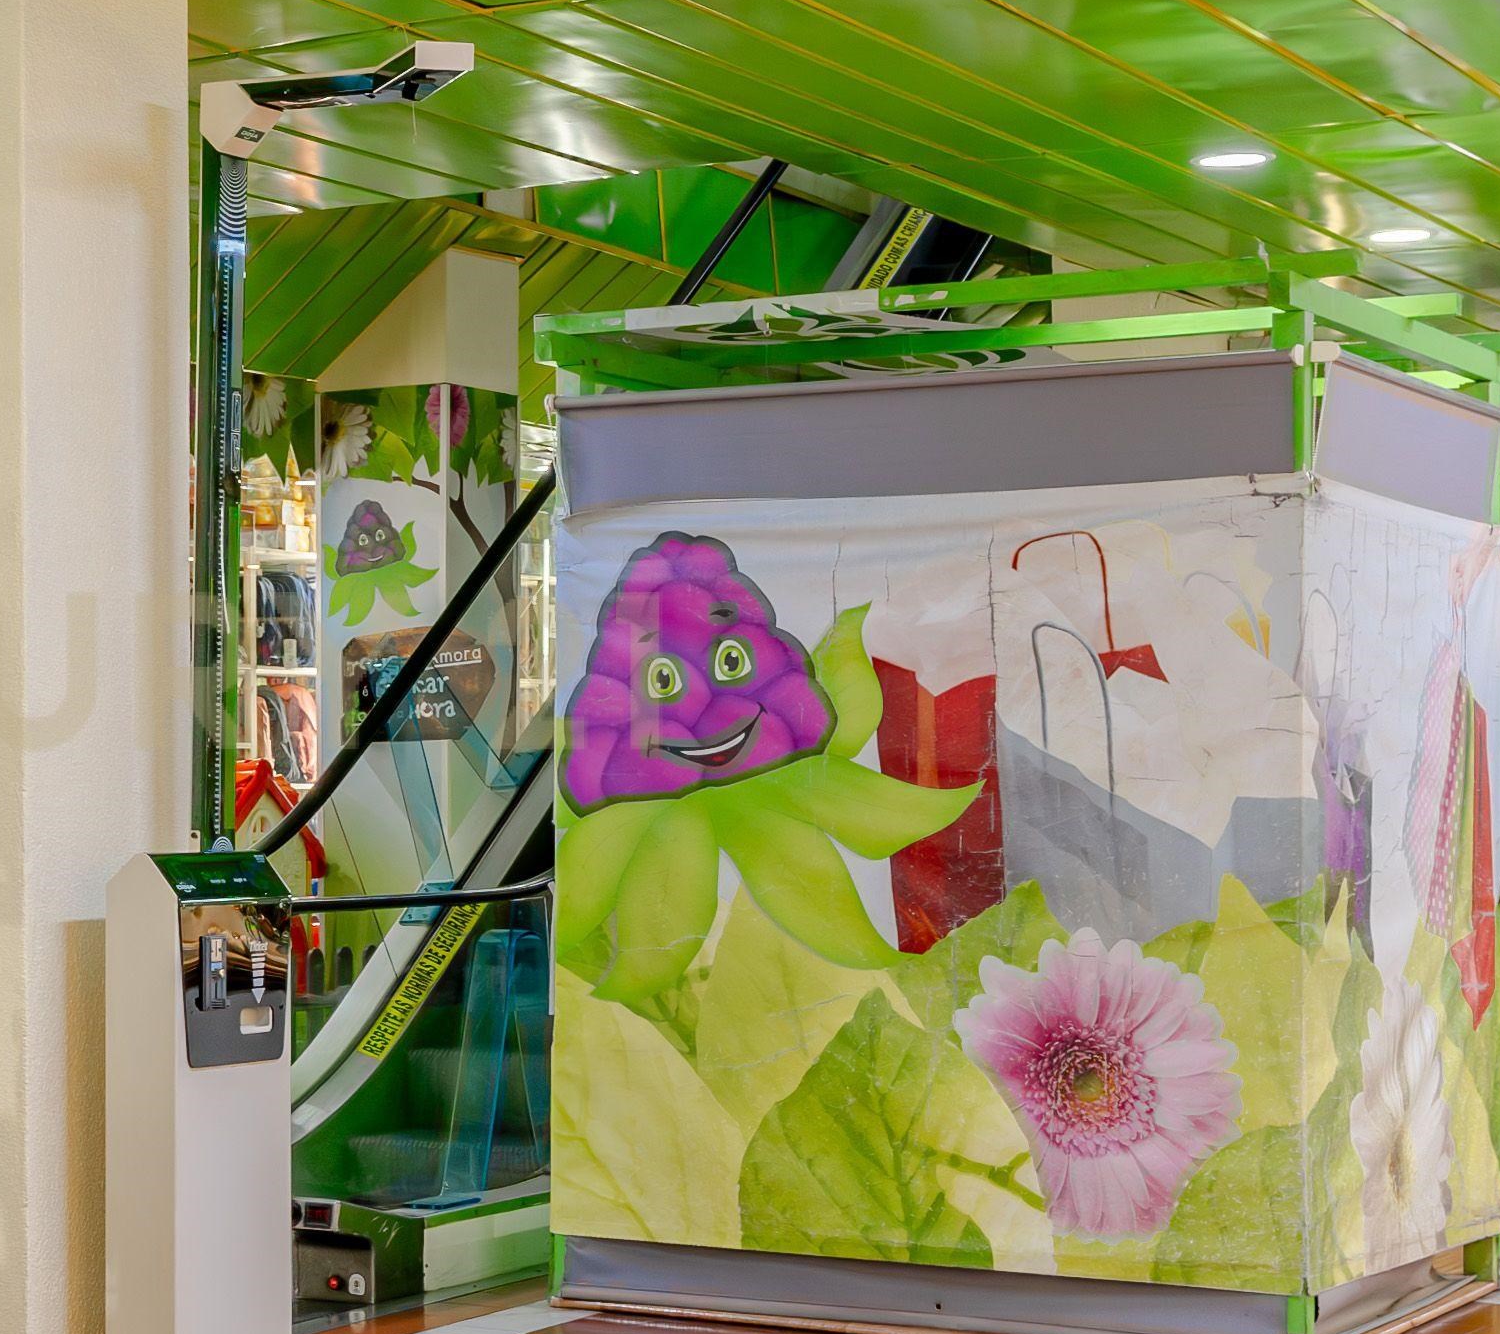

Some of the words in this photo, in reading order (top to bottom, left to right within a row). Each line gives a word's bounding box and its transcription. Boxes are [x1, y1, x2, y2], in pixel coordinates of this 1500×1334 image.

[424, 948, 447, 966] DE
[400, 961, 438, 1003] NORMAS
[391, 999, 415, 1018] AS
[362, 1012, 401, 1056] RESPEITE
